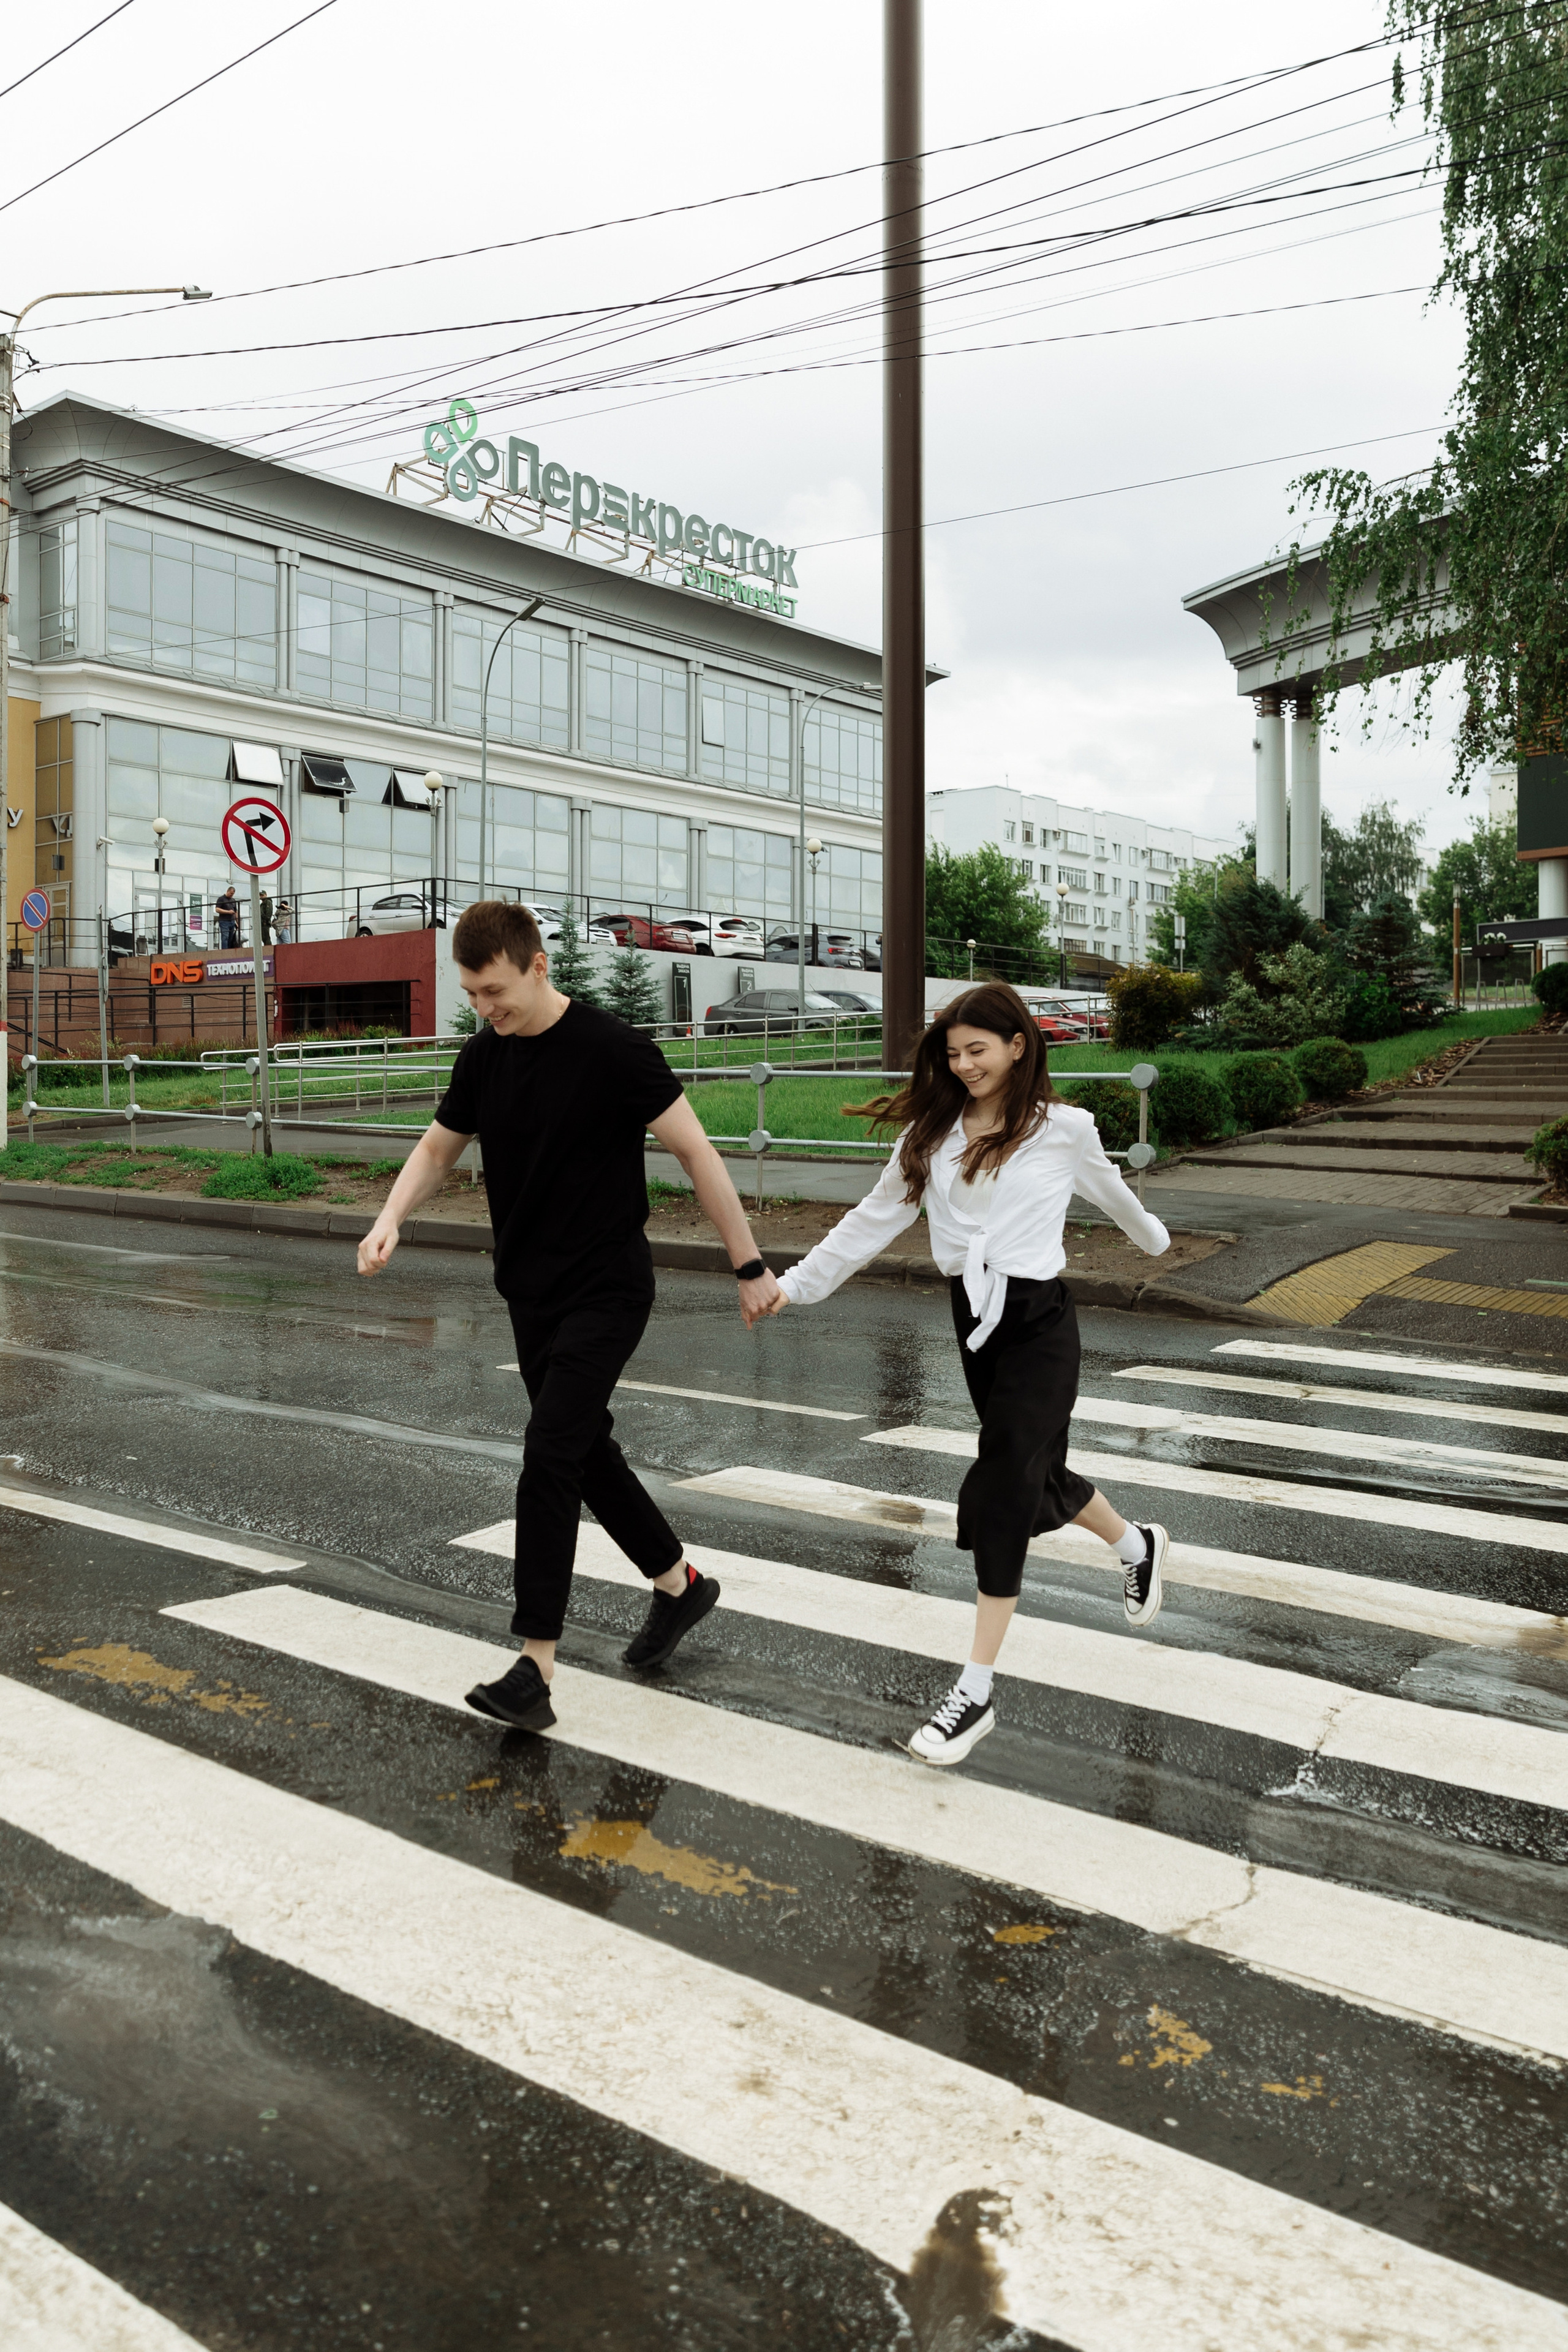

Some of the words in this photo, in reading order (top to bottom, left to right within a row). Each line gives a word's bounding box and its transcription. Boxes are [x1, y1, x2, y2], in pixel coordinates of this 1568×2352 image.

[682, 564, 798, 619] СУПЕРМАРКЕТ
[151, 960, 204, 984] DNS
[206, 960, 271, 976] ТЕХНОПОИТ
[683, 978, 687, 988] 1
[747, 982, 752, 991] 2
